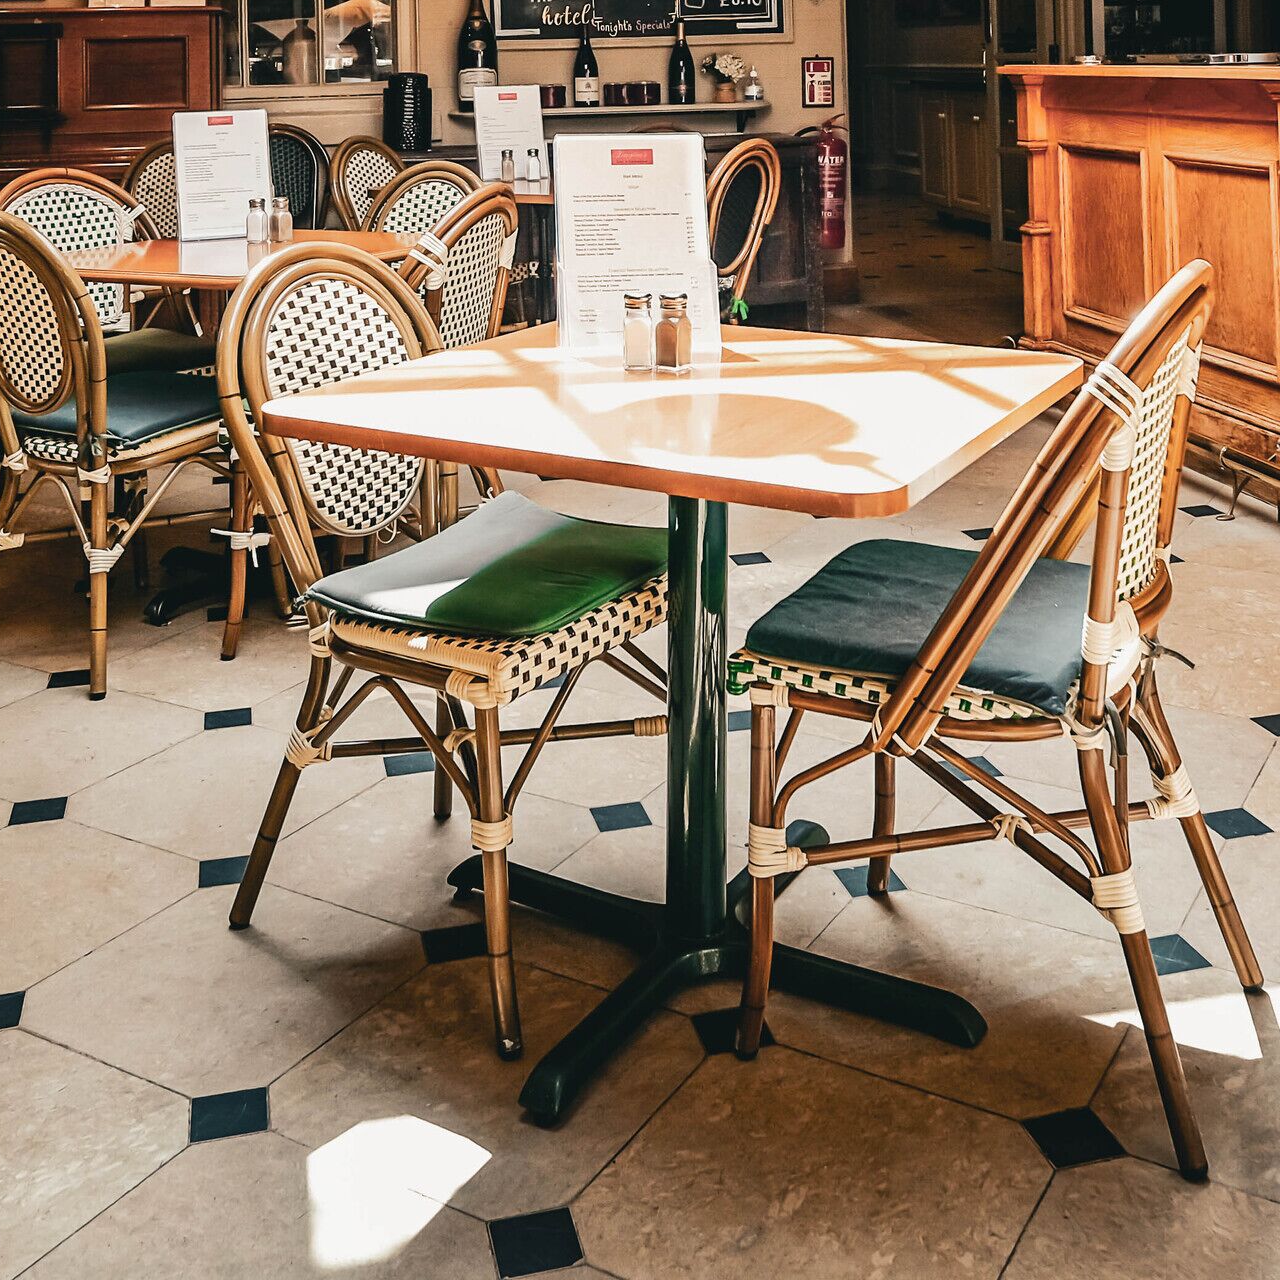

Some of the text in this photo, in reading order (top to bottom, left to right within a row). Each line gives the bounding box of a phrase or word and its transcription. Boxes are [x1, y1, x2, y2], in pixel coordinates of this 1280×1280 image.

[541, 3, 592, 25] hotel
[595, 20, 671, 37] Tonight's Specials
